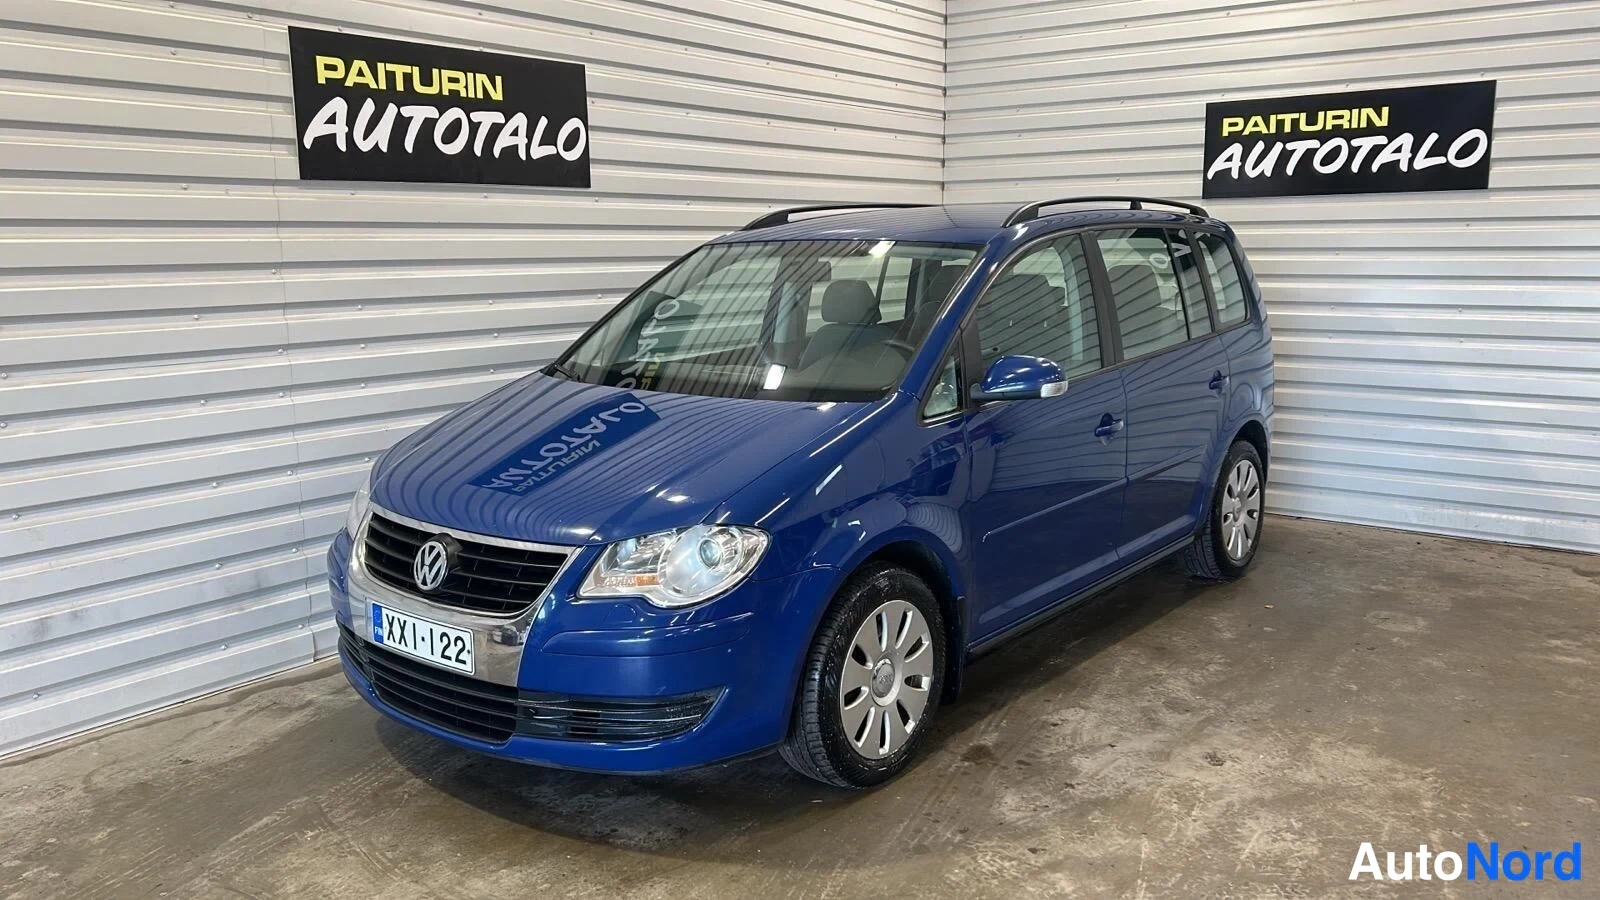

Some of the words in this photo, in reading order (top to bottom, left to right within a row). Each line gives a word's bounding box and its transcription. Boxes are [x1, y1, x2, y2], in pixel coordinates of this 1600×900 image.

[315, 55, 503, 101] PAITURIN
[303, 97, 587, 161] AUTOTALO
[1222, 106, 1390, 137] PAITURIN
[1207, 128, 1488, 180] AUTOTALO
